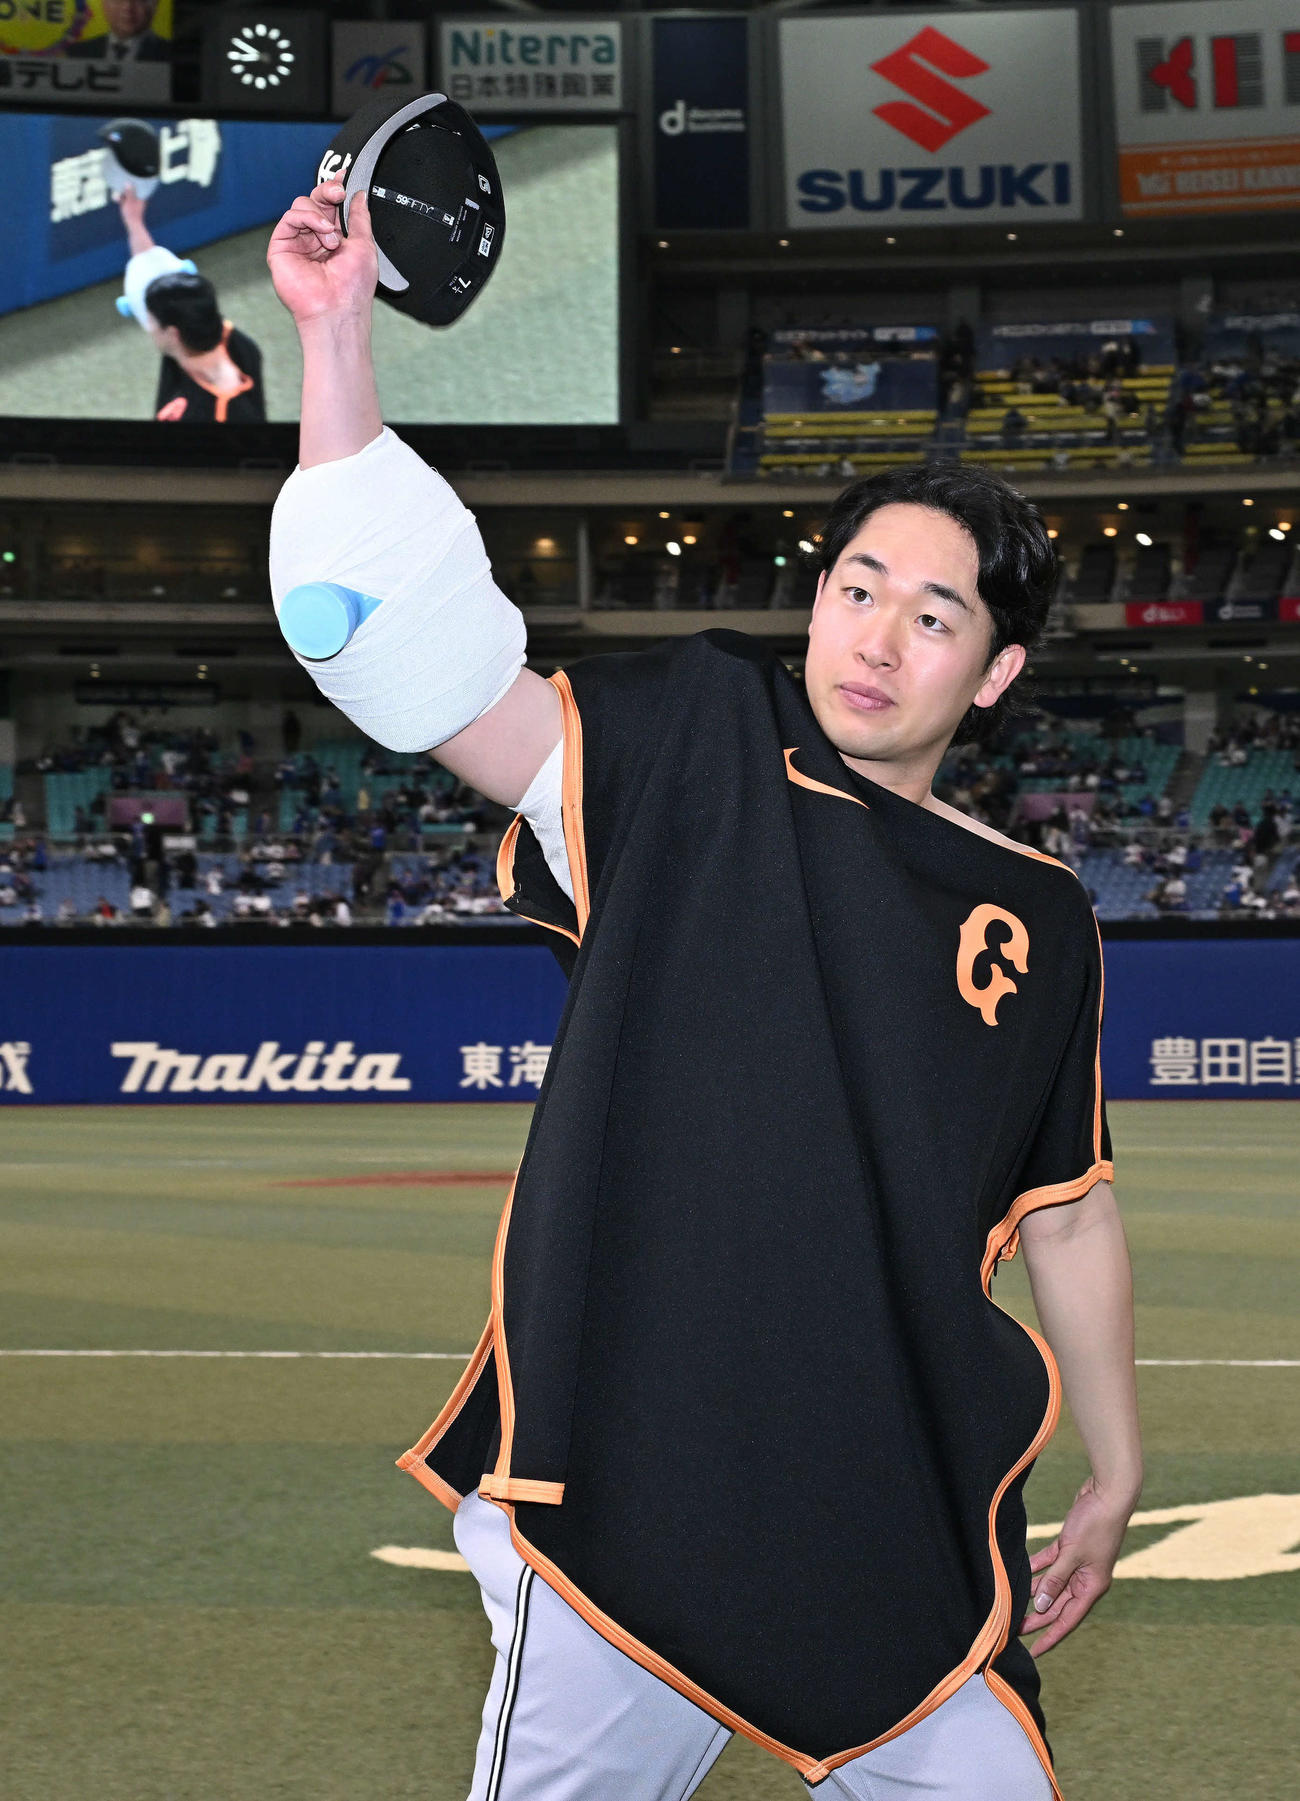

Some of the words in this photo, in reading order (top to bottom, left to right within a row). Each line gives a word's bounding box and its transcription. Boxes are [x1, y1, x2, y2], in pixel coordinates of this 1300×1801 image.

[451, 29, 616, 66] Niterra
[797, 162, 1070, 213] SUZUKI
[956, 903, 1030, 1027] G
[111, 1042, 411, 1093] Makita
[459, 1041, 553, 1090] 東海
[1149, 1035, 1300, 1086] 豊田自
